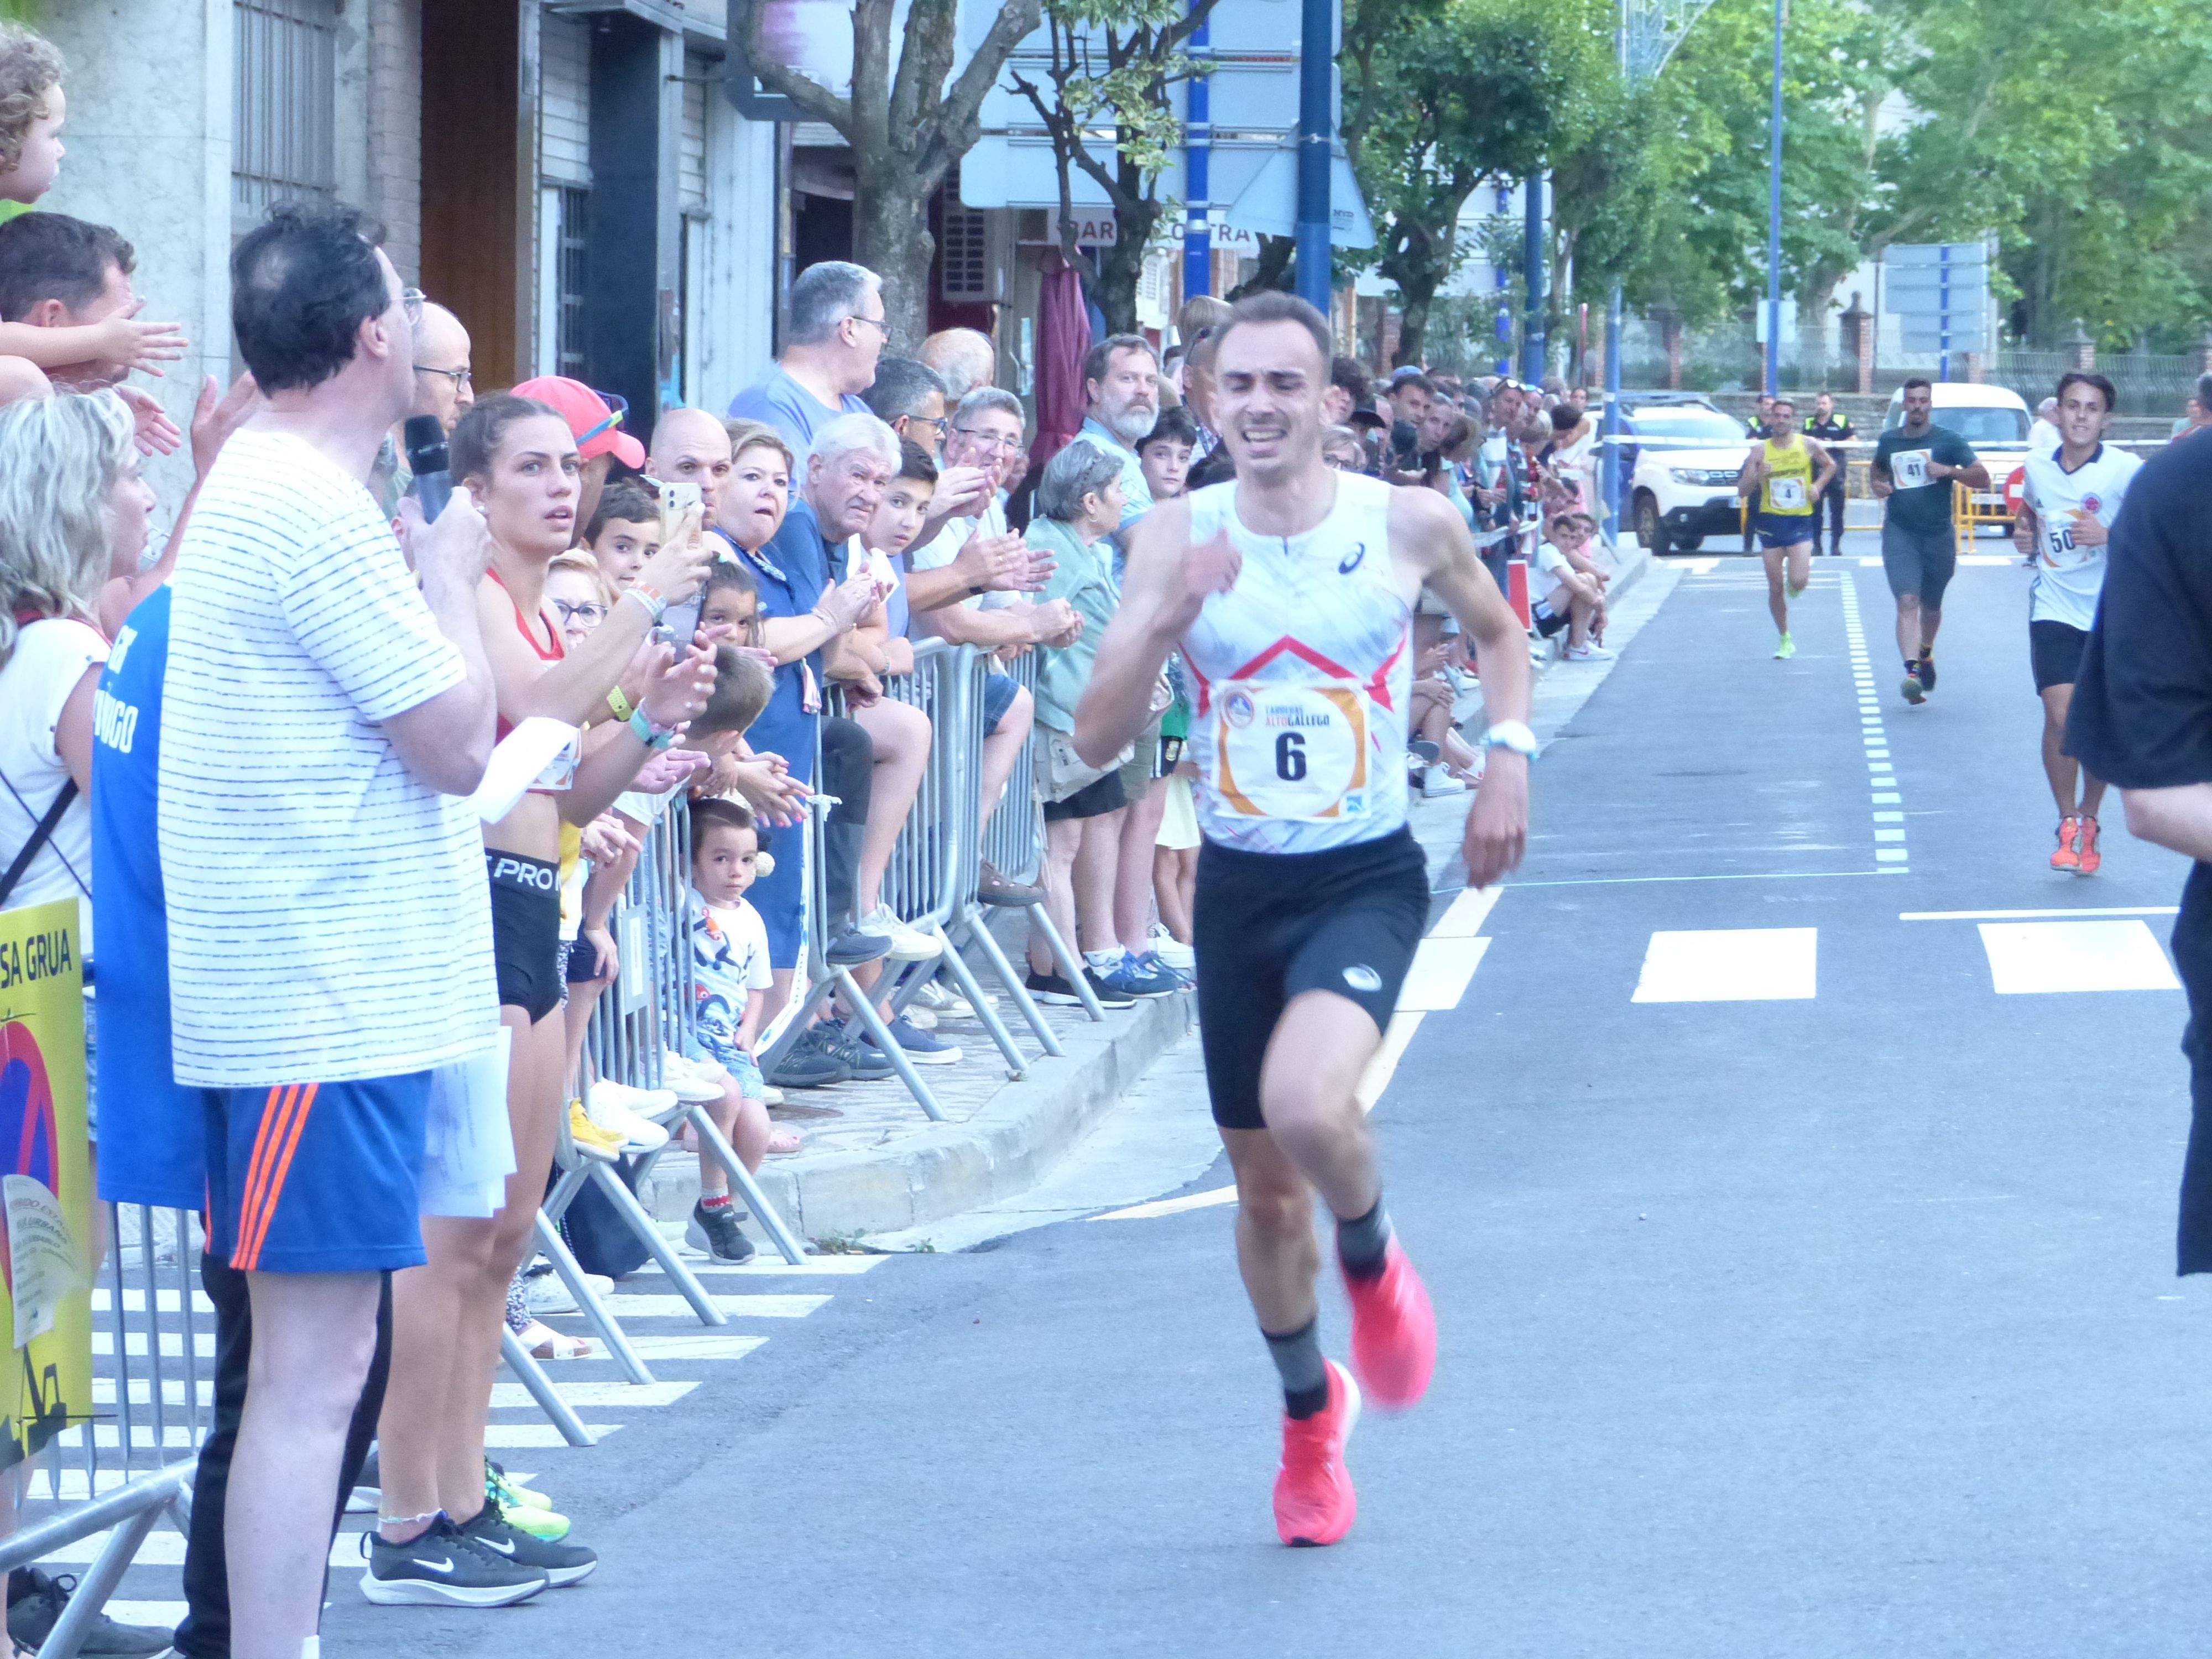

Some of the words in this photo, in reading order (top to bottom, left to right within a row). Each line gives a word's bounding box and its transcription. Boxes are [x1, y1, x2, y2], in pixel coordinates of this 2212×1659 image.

[2049, 529, 2076, 553] 50
[1275, 732, 1307, 781] 6
[494, 858, 553, 890] PRO
[26, 928, 72, 980] GRUA
